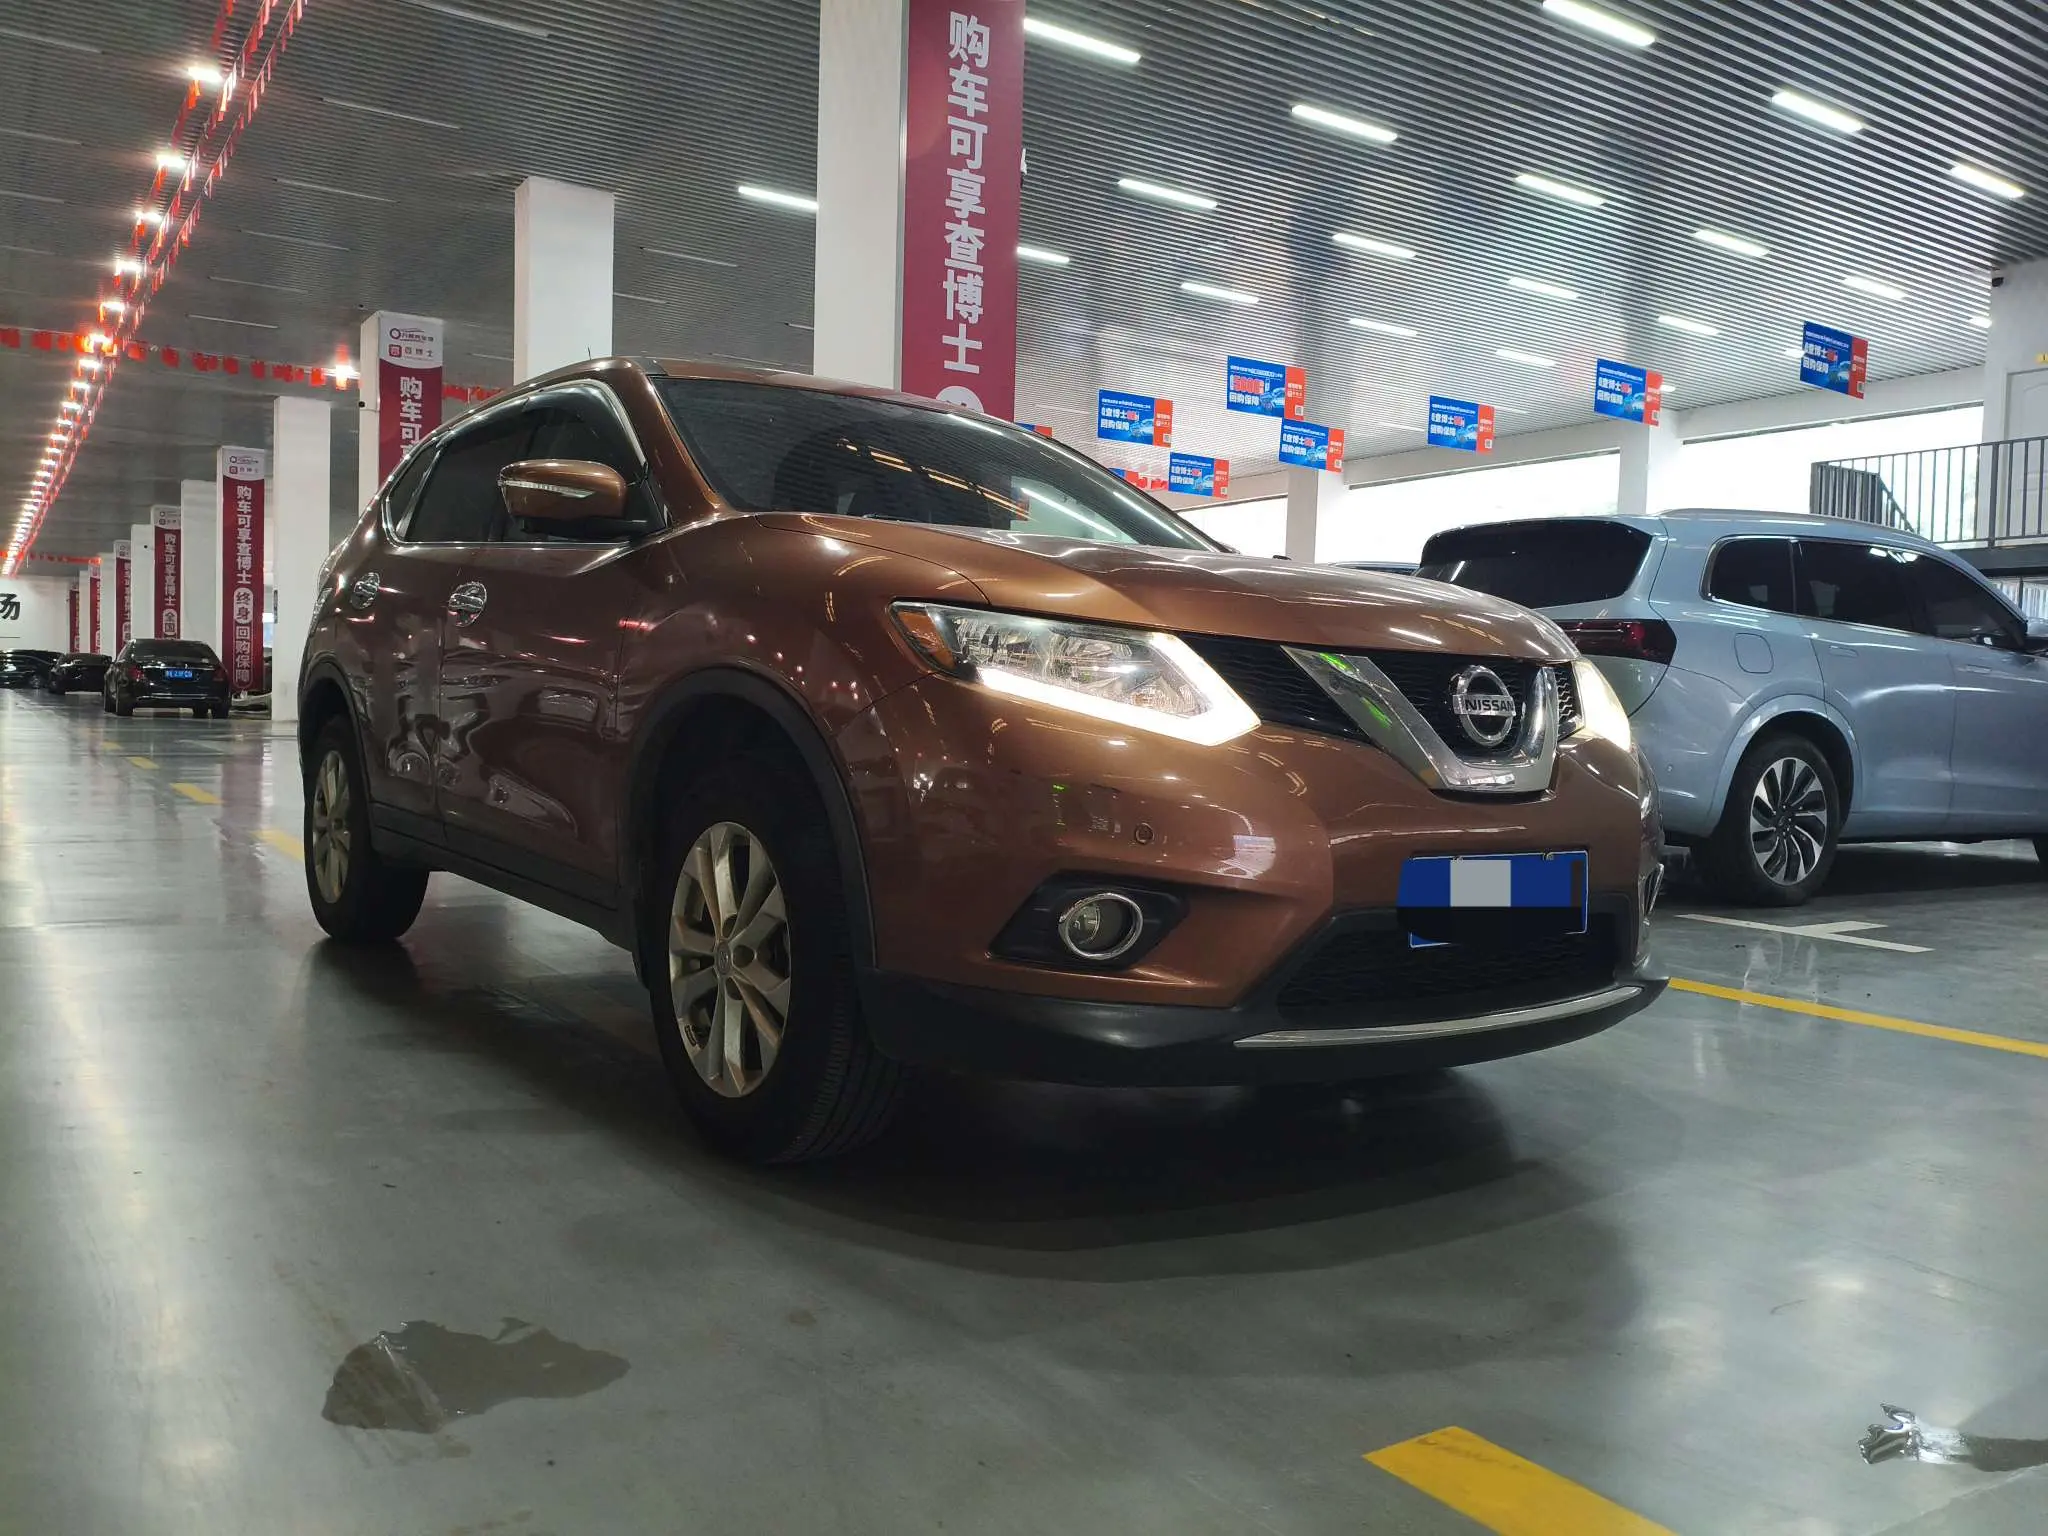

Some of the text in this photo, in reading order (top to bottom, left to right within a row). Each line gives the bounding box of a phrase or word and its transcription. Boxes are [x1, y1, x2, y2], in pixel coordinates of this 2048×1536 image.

[941, 11, 991, 374] 购车可享查博士
[236, 485, 253, 585] 购车可享查博士
[1465, 699, 1515, 712] NISSAN
